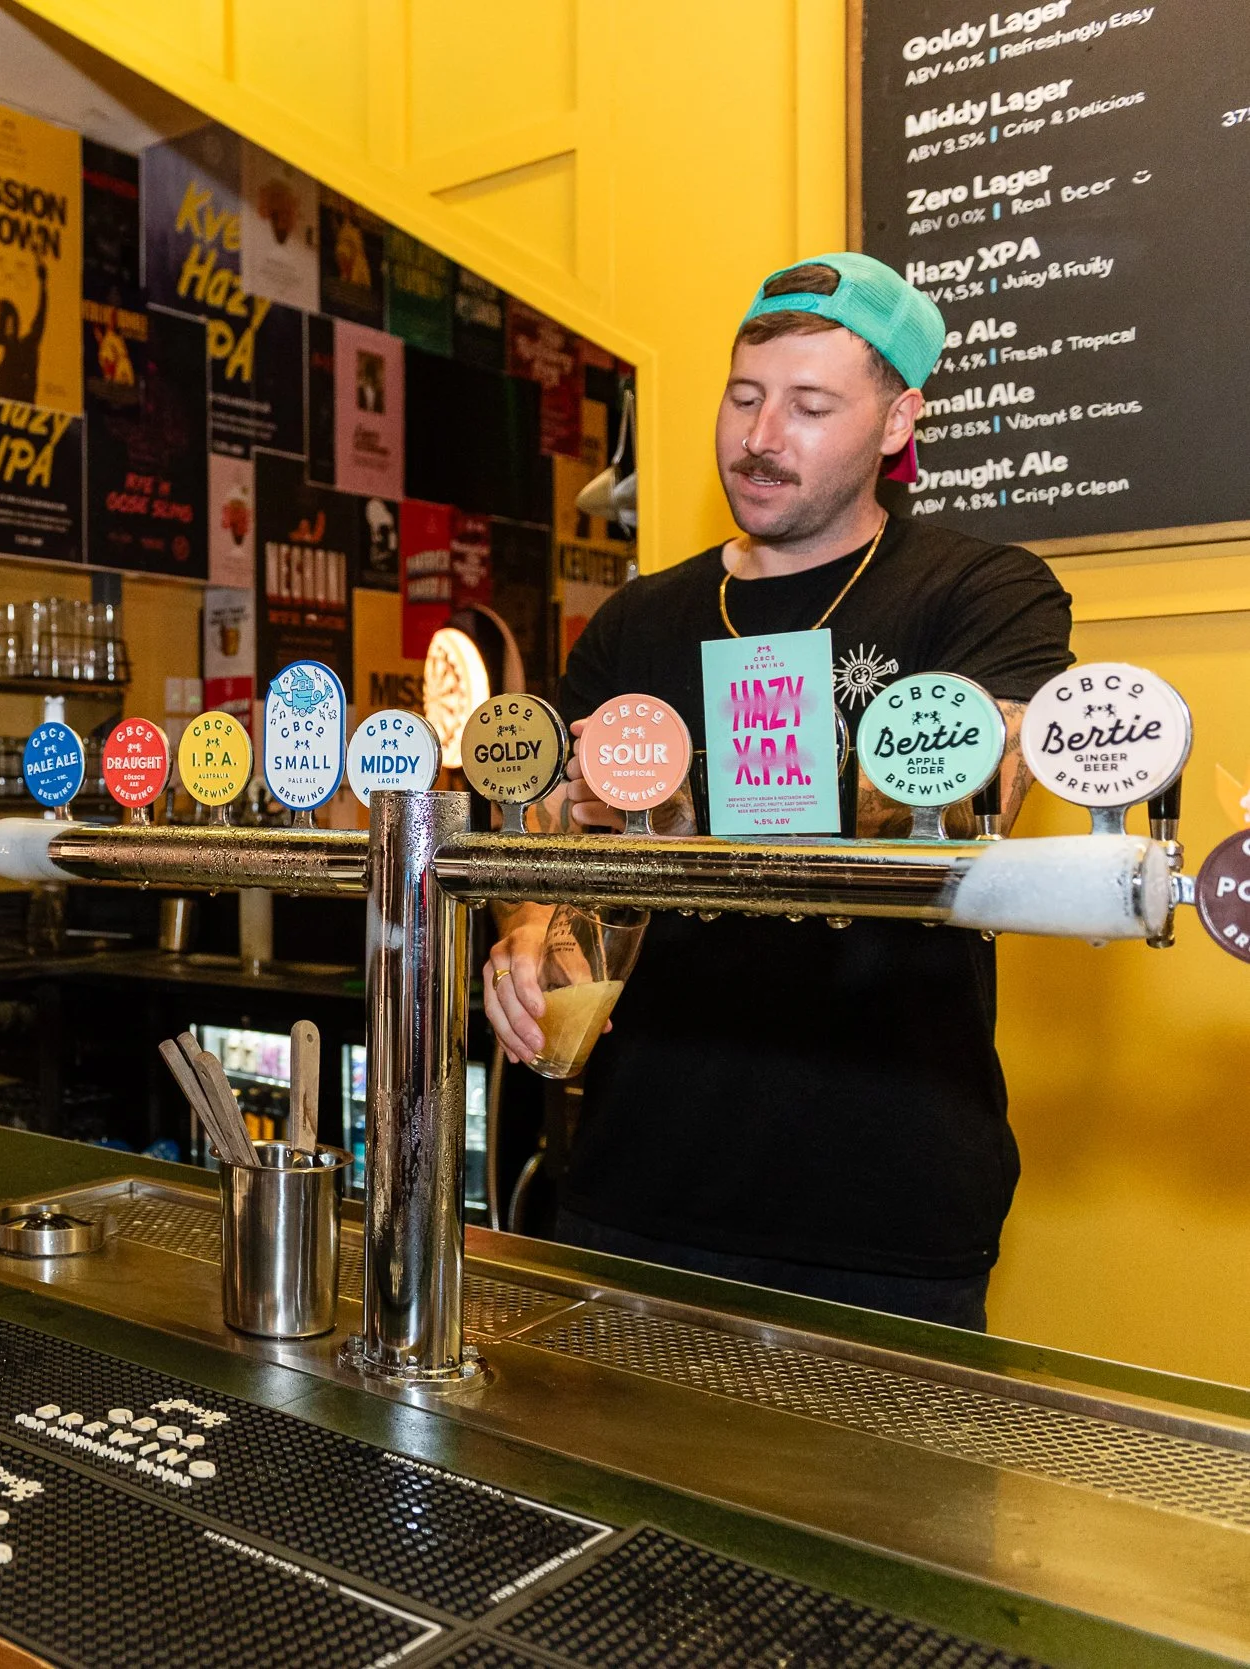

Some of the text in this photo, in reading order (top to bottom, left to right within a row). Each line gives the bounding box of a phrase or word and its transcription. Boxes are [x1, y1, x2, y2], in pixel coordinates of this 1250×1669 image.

[903, 0, 1072, 61] Goldy Lager
[905, 7, 1154, 86] ABV 4.0% Refreshingly Easy
[905, 79, 1073, 138] Middy Lager
[906, 91, 1146, 163] ABV 3.5% Crisp & Delicious
[907, 165, 1053, 214] Zero Lager
[908, 178, 1116, 237] ABV 0.0% Real Beer
[906, 237, 1041, 286] Hazy XPA
[943, 281, 985, 303] 4.5%
[1002, 270, 1047, 289] Juicy
[1047, 262, 1062, 280] &
[1063, 255, 1114, 278] Fruity
[965, 317, 1017, 344] Ale
[206, 319, 257, 384] PA
[944, 352, 987, 373] 4.4%
[1001, 345, 1048, 364] Fresh
[1051, 339, 1063, 355] &
[1066, 326, 1136, 352] Tropical
[987, 382, 1035, 407] Ale
[915, 400, 1143, 443] ABV Vibrant & Citrus
[908, 451, 1069, 494] Draught Ale
[911, 478, 1129, 516] ABV 4.8% Crisp & Clean
[744, 662, 785, 671] BREWING
[730, 676, 804, 732] HAZY
[874, 721, 979, 758] Bertie
[1041, 714, 1161, 754] Bertie
[27, 752, 79, 776] PALE ALE
[106, 756, 163, 770] DRAUGHT
[274, 755, 331, 770] SMALL
[361, 755, 421, 774] MIDDY
[474, 740, 542, 763] GOLDY
[599, 742, 669, 765] SOUR
[733, 734, 812, 786] X.P.A.
[907, 757, 945, 766] APPLE
[1074, 753, 1128, 762] GINGER
[612, 769, 656, 777] TROPICAL
[907, 766, 944, 775] CIDER
[1083, 763, 1118, 771] BEER
[38, 782, 73, 800] BREWING
[115, 785, 154, 801] BREWING
[193, 782, 234, 798] BREWING
[278, 786, 325, 804] BREWING
[482, 775, 538, 795] BREWING
[601, 780, 668, 802] BREWING
[885, 772, 967, 795] BREWING
[1055, 770, 1148, 794] BREWING
[1223, 923, 1250, 953] BR
[35, 1403, 216, 1478] BREWING
[383, 1452, 477, 1488] MARGARET RIVER
[204, 1529, 300, 1574] MARGARET RIVER
